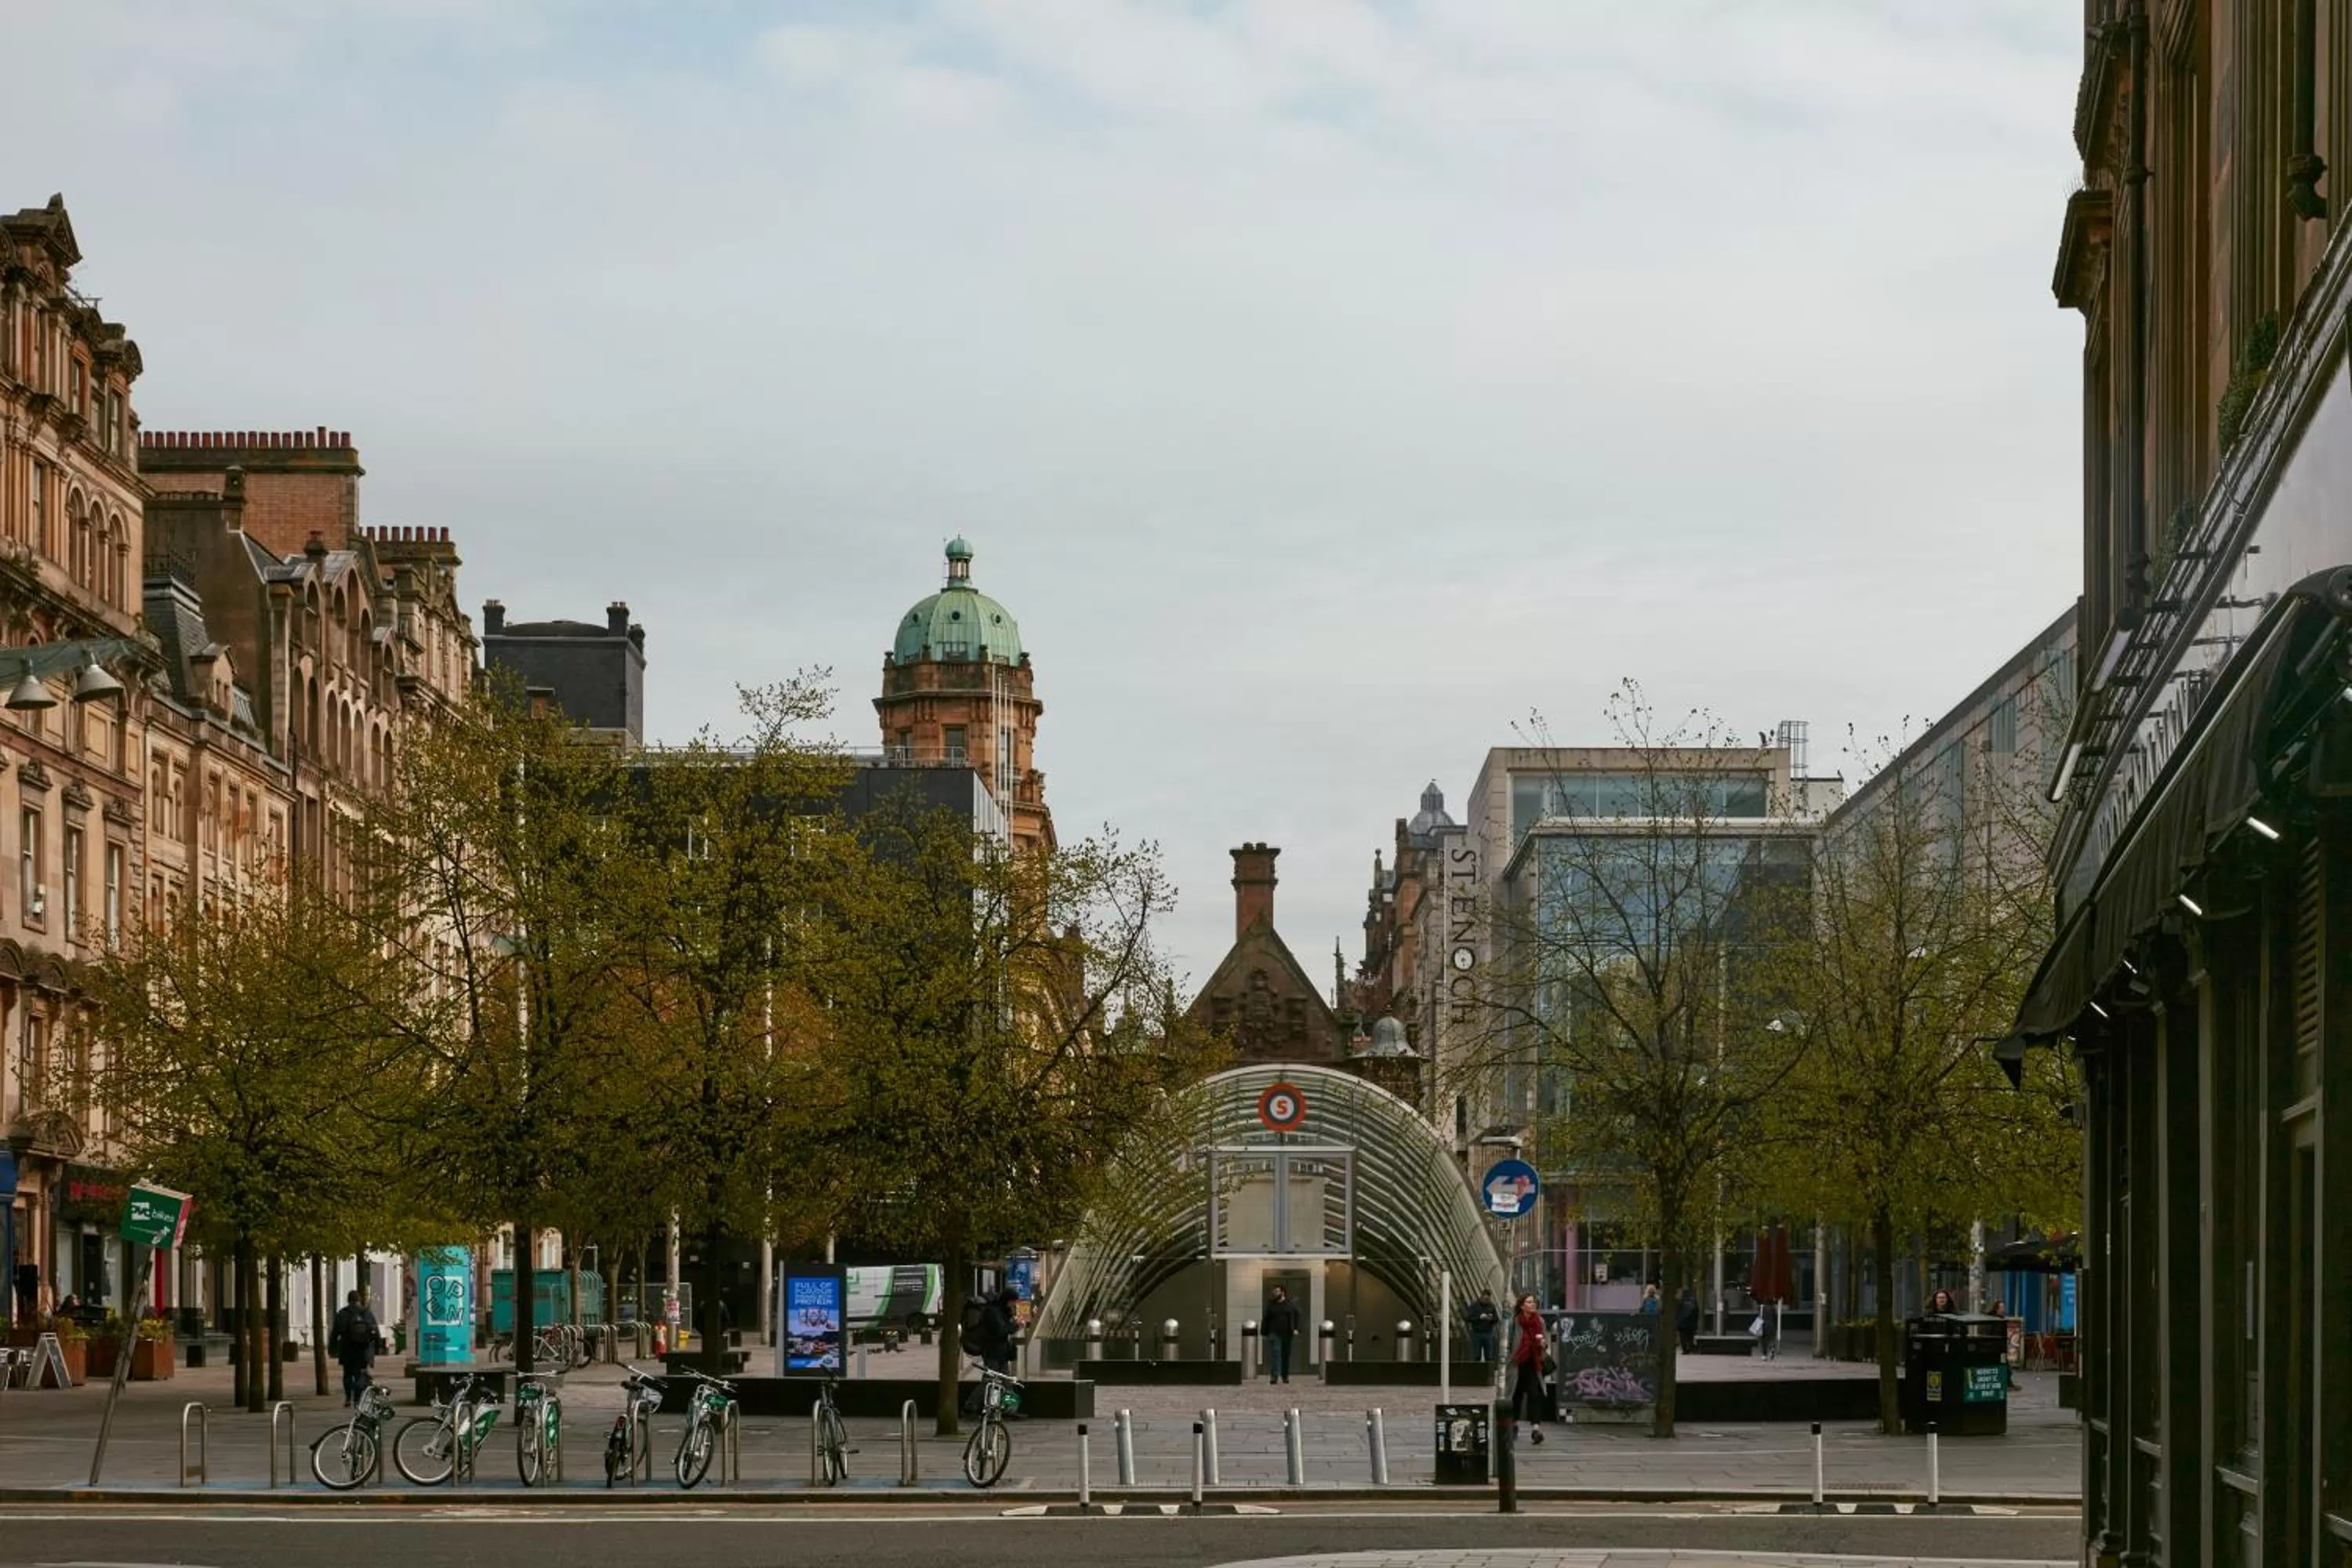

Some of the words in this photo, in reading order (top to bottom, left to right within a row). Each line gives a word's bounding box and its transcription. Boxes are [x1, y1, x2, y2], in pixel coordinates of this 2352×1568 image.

[1451, 849, 1476, 884] ST
[1451, 895, 1476, 1024] ENOCH
[1276, 1099, 1289, 1115] S
[151, 1208, 175, 1222] bikes
